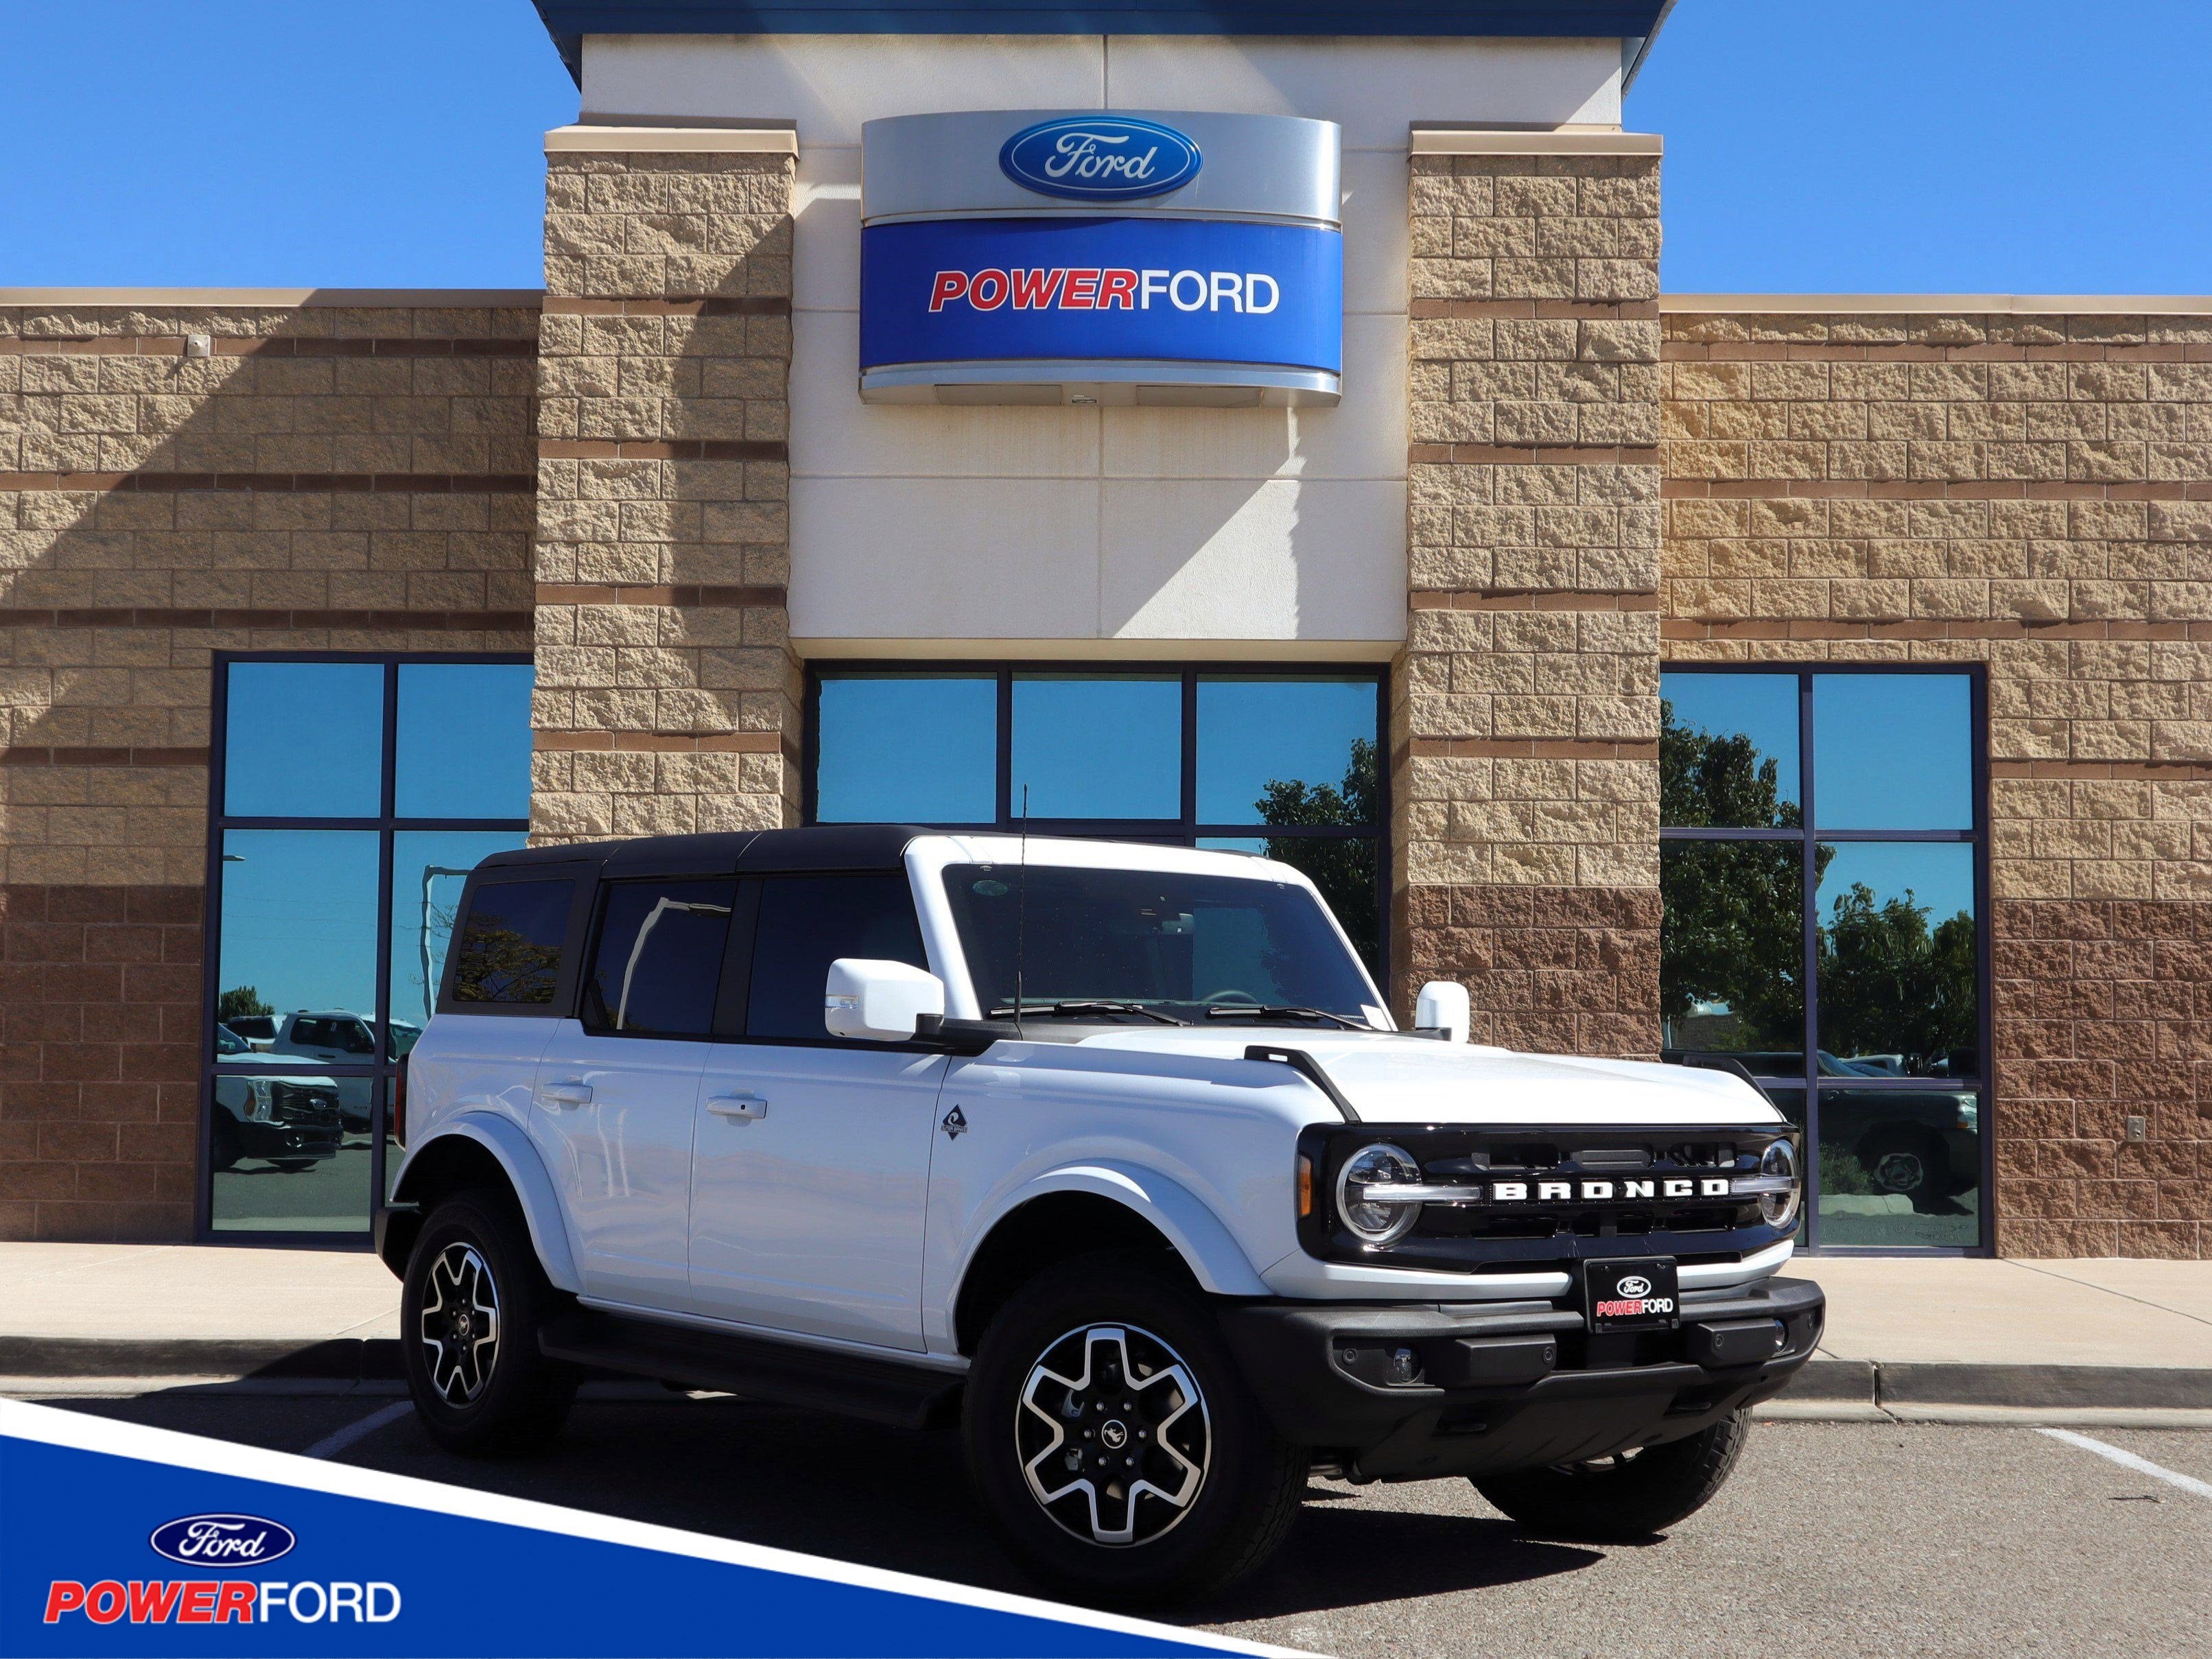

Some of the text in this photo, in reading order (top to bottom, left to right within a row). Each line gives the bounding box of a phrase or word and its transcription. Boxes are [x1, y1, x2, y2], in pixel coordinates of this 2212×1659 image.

[1044, 132, 1157, 180] Ford
[1492, 1179, 1730, 1201] BRONCO
[1623, 1280, 1644, 1293] Ford
